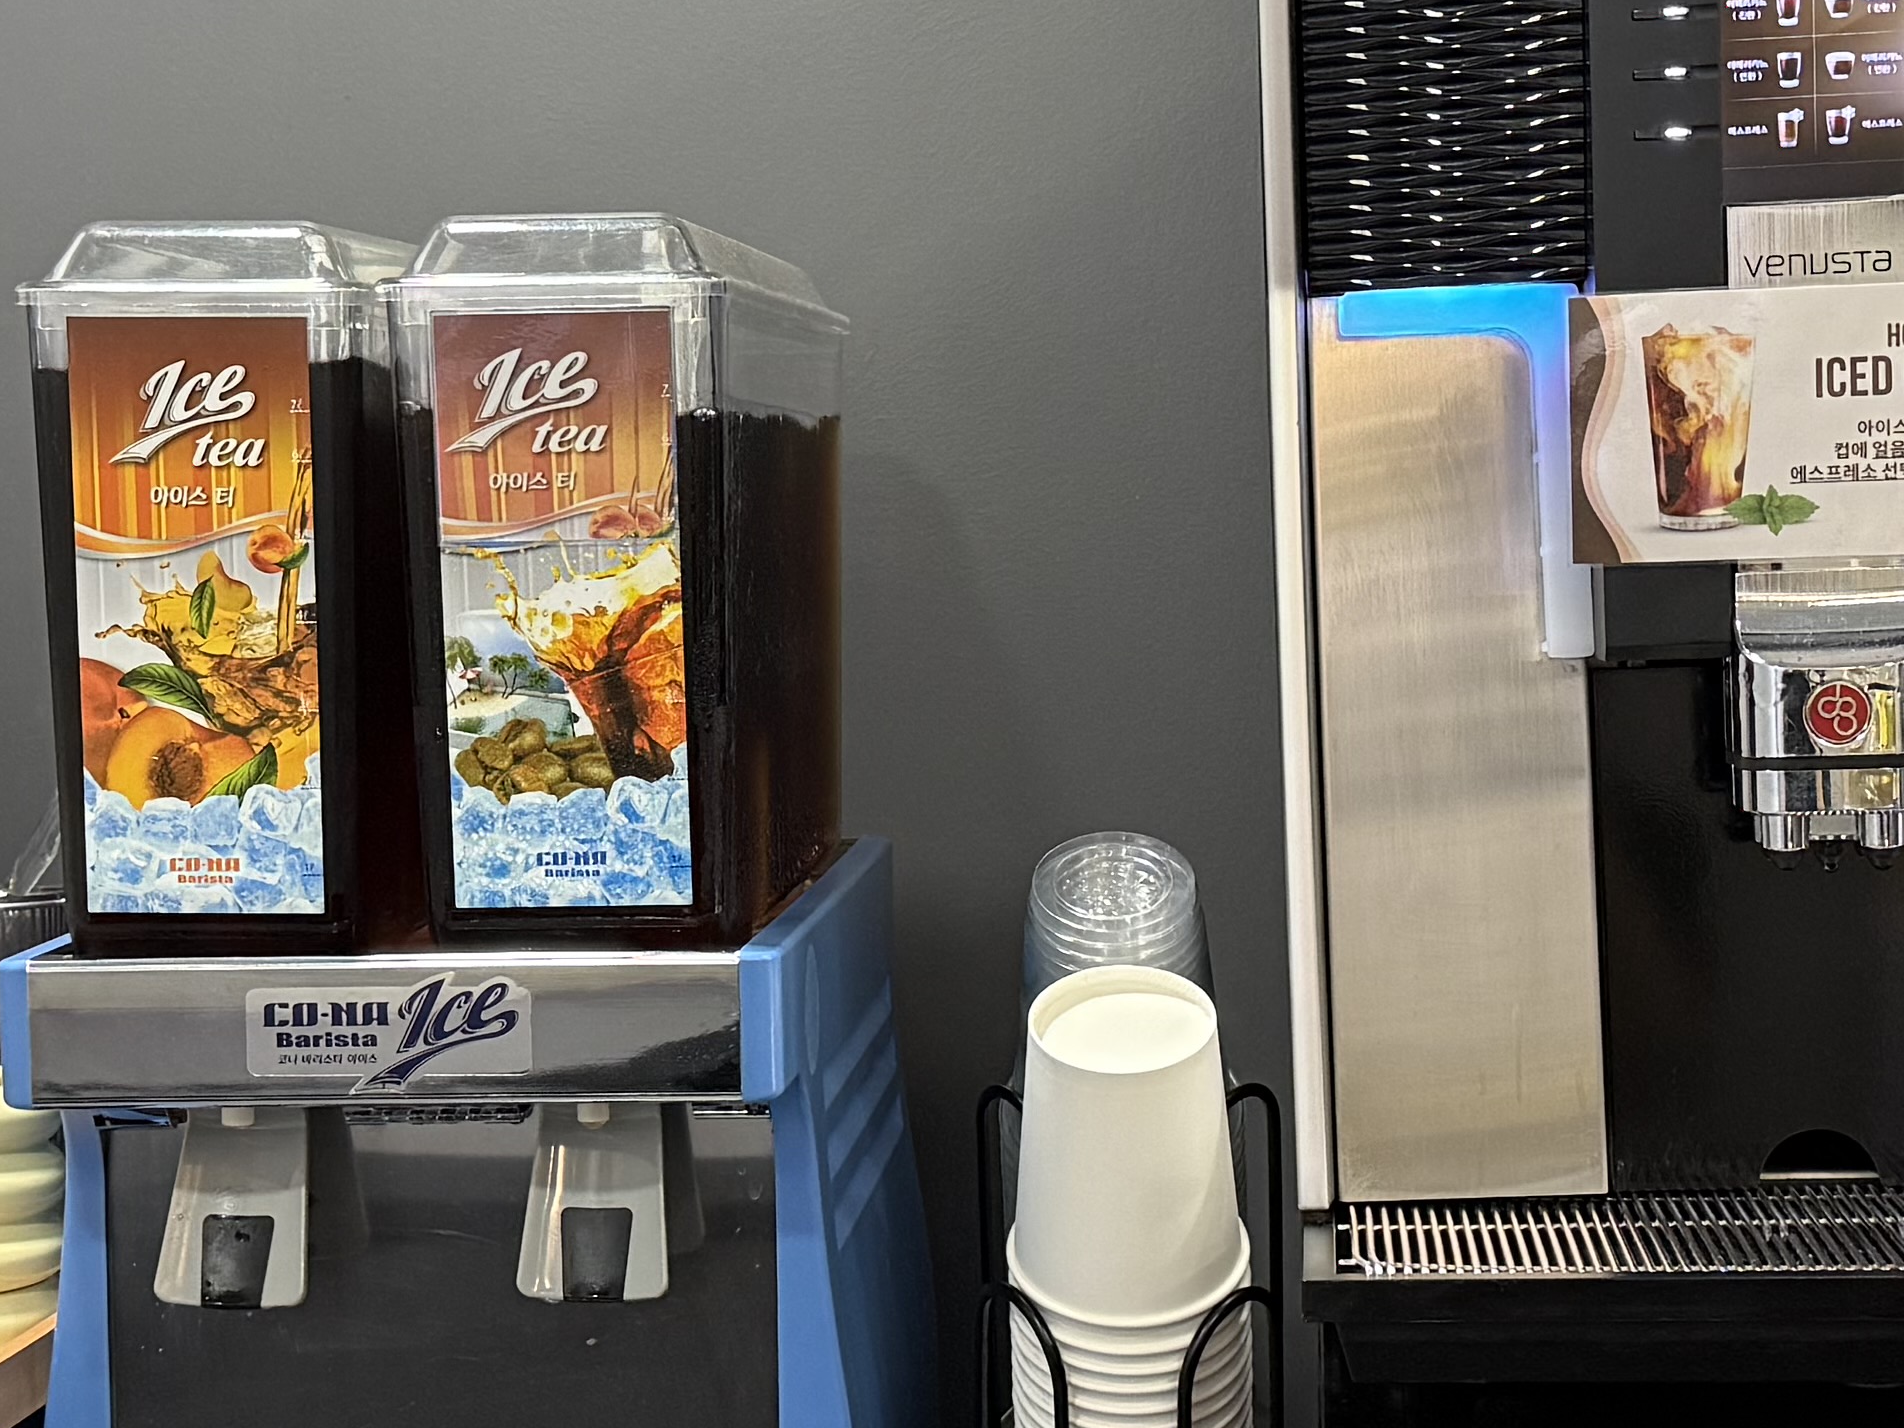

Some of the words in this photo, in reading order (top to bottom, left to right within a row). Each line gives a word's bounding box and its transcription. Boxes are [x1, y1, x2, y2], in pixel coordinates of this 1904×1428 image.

[1815, 355, 1894, 399] ICED
[129, 359, 256, 443] Ice
[460, 348, 598, 434] Ice
[532, 414, 608, 453] tea
[192, 429, 266, 468] tea
[1834, 441, 1867, 460] 컵에
[489, 472, 549, 493] 아이스
[557, 472, 576, 491] 티
[1790, 464, 1878, 484] 에스프레소
[150, 485, 208, 508] 아이스
[214, 486, 236, 508] 티
[177, 874, 234, 884] Barista
[544, 867, 601, 878] Barista
[385, 976, 520, 1065] Ice
[276, 1032, 378, 1048] Barista
